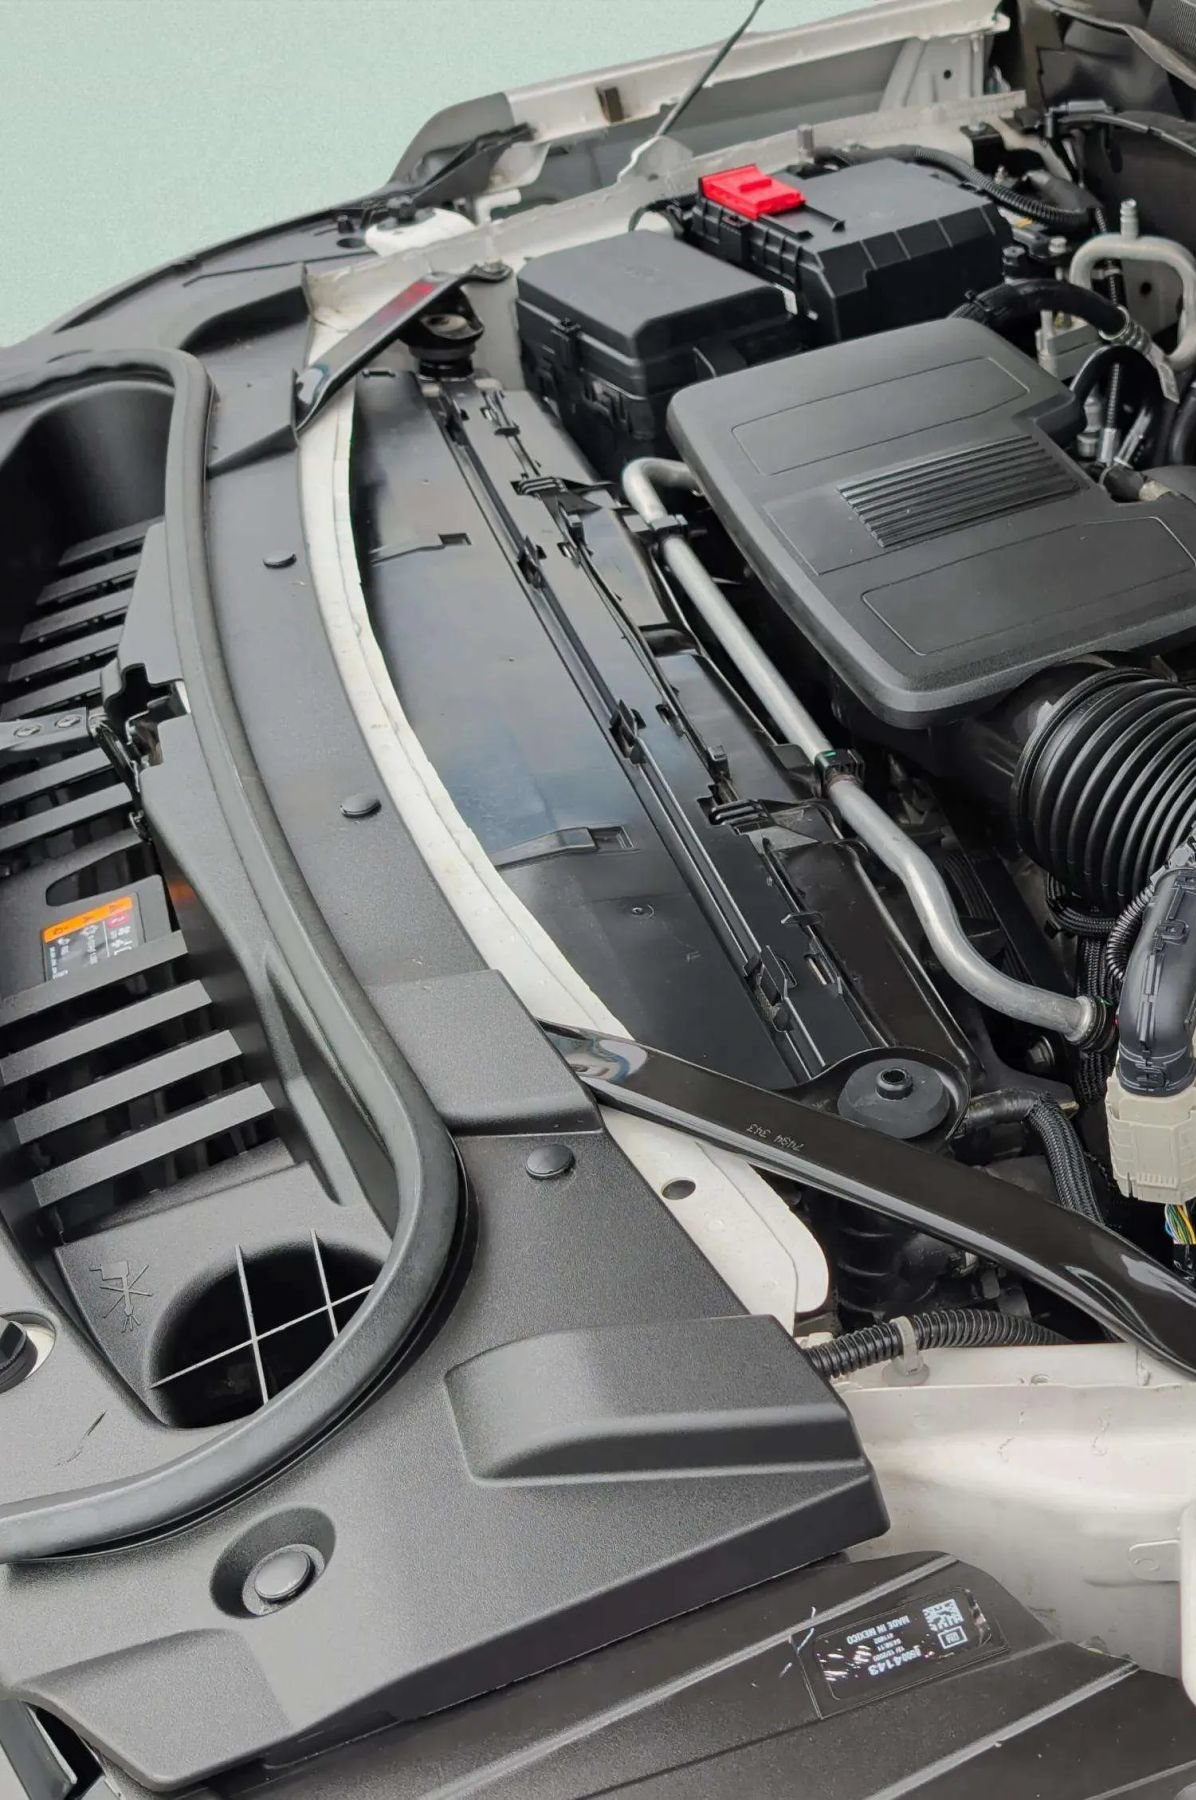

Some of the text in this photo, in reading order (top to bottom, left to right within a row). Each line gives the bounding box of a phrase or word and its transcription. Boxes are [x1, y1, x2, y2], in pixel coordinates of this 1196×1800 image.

[846, 1615, 911, 1645] MADE IN MEXICO
